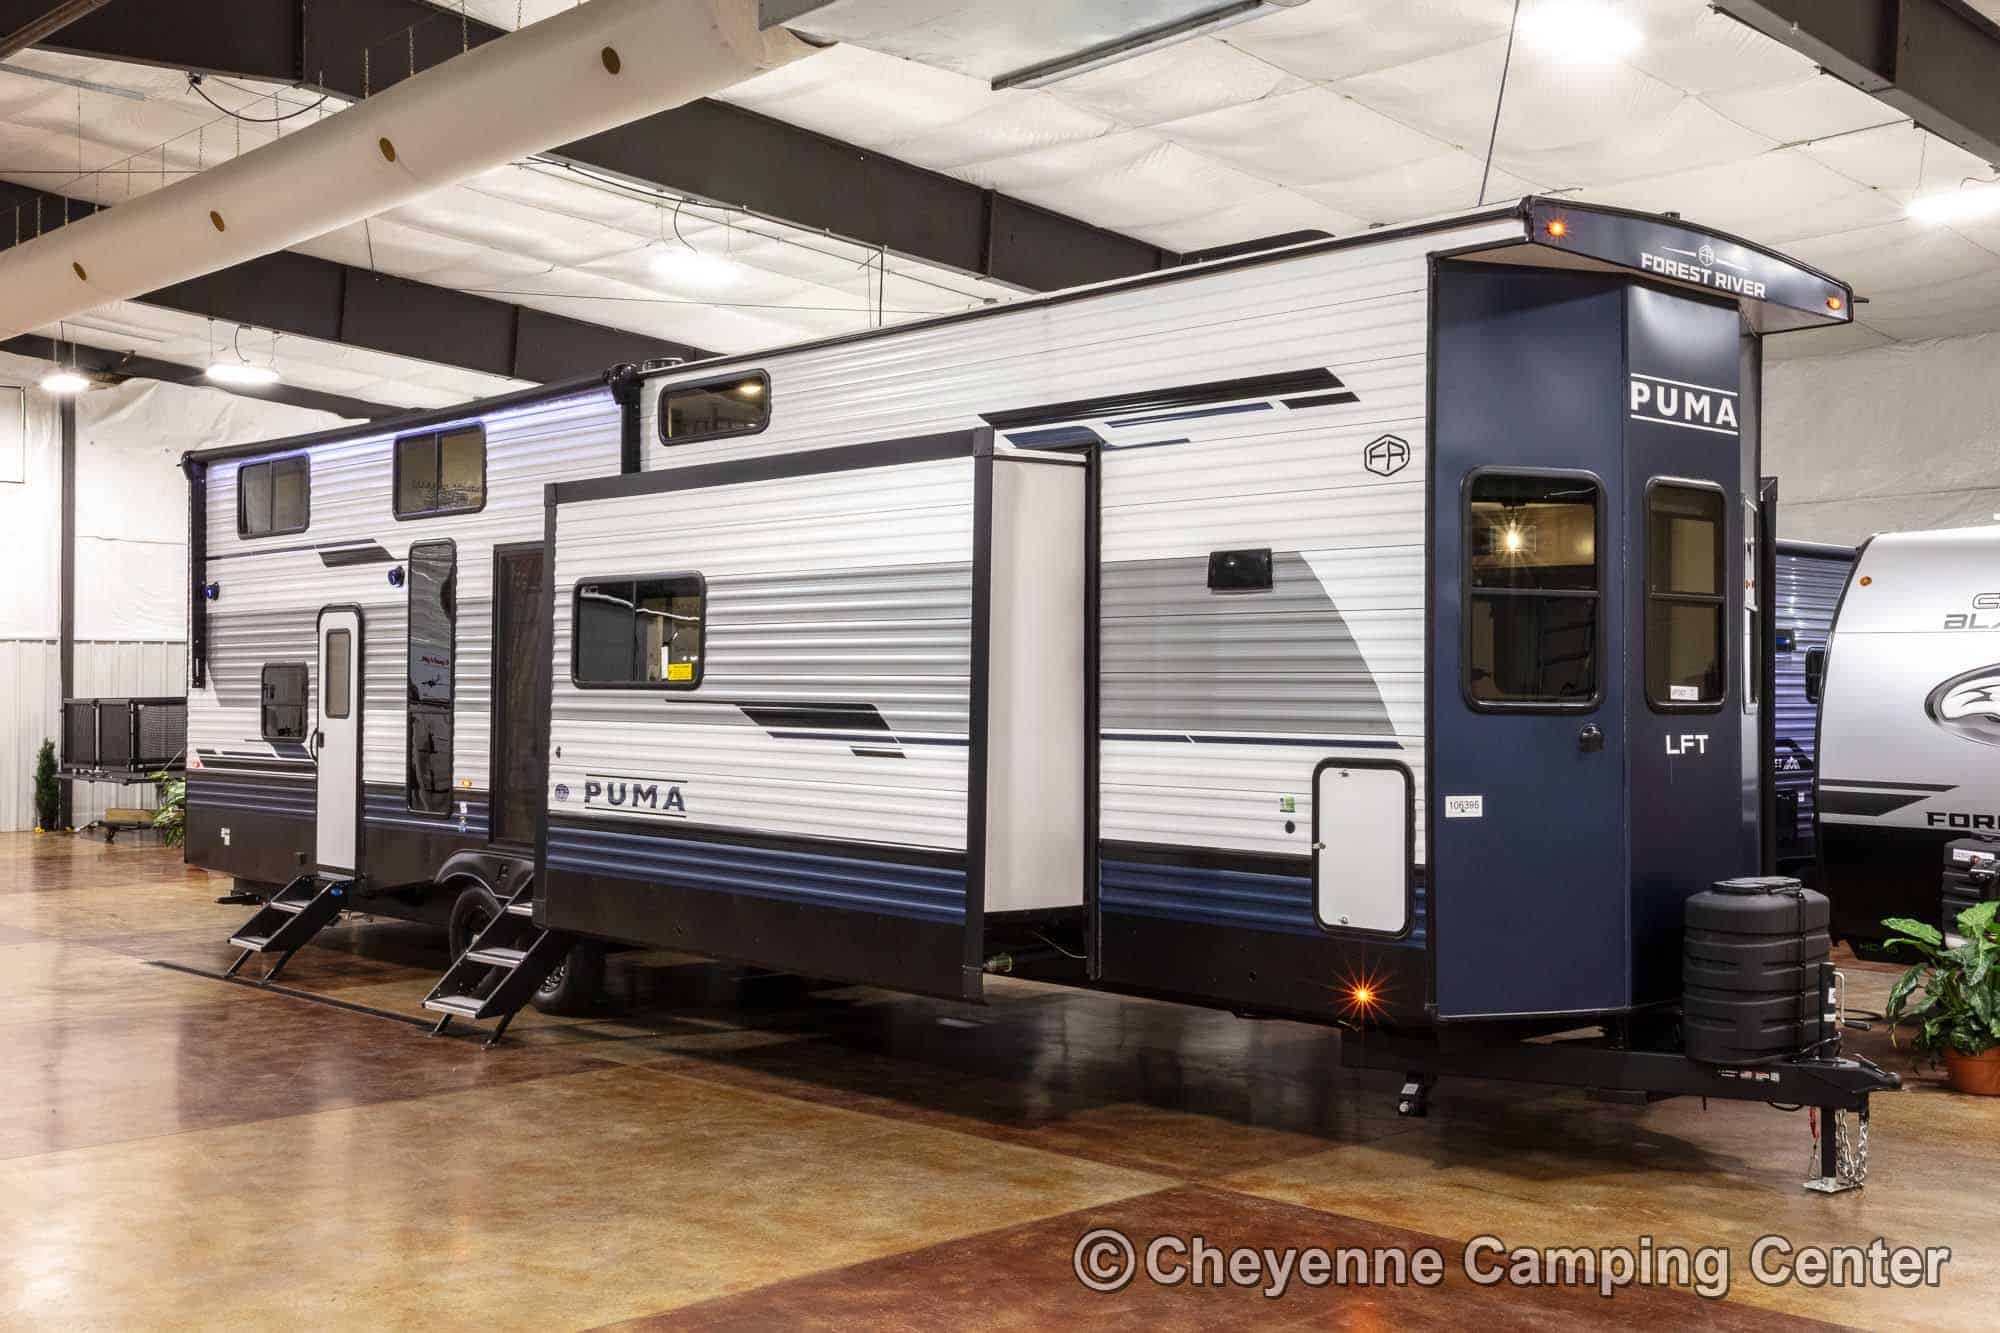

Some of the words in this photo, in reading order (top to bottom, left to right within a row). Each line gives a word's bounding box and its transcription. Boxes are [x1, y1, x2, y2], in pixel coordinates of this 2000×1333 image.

[1640, 252, 1712, 284] FOREST
[1715, 271, 1766, 298] RIVER
[1630, 381, 1738, 428] PUMA
[1943, 613, 2000, 630] BL
[1665, 734, 1709, 754] LFT
[584, 781, 686, 812] PUMA
[1926, 811, 2000, 830] FOR
